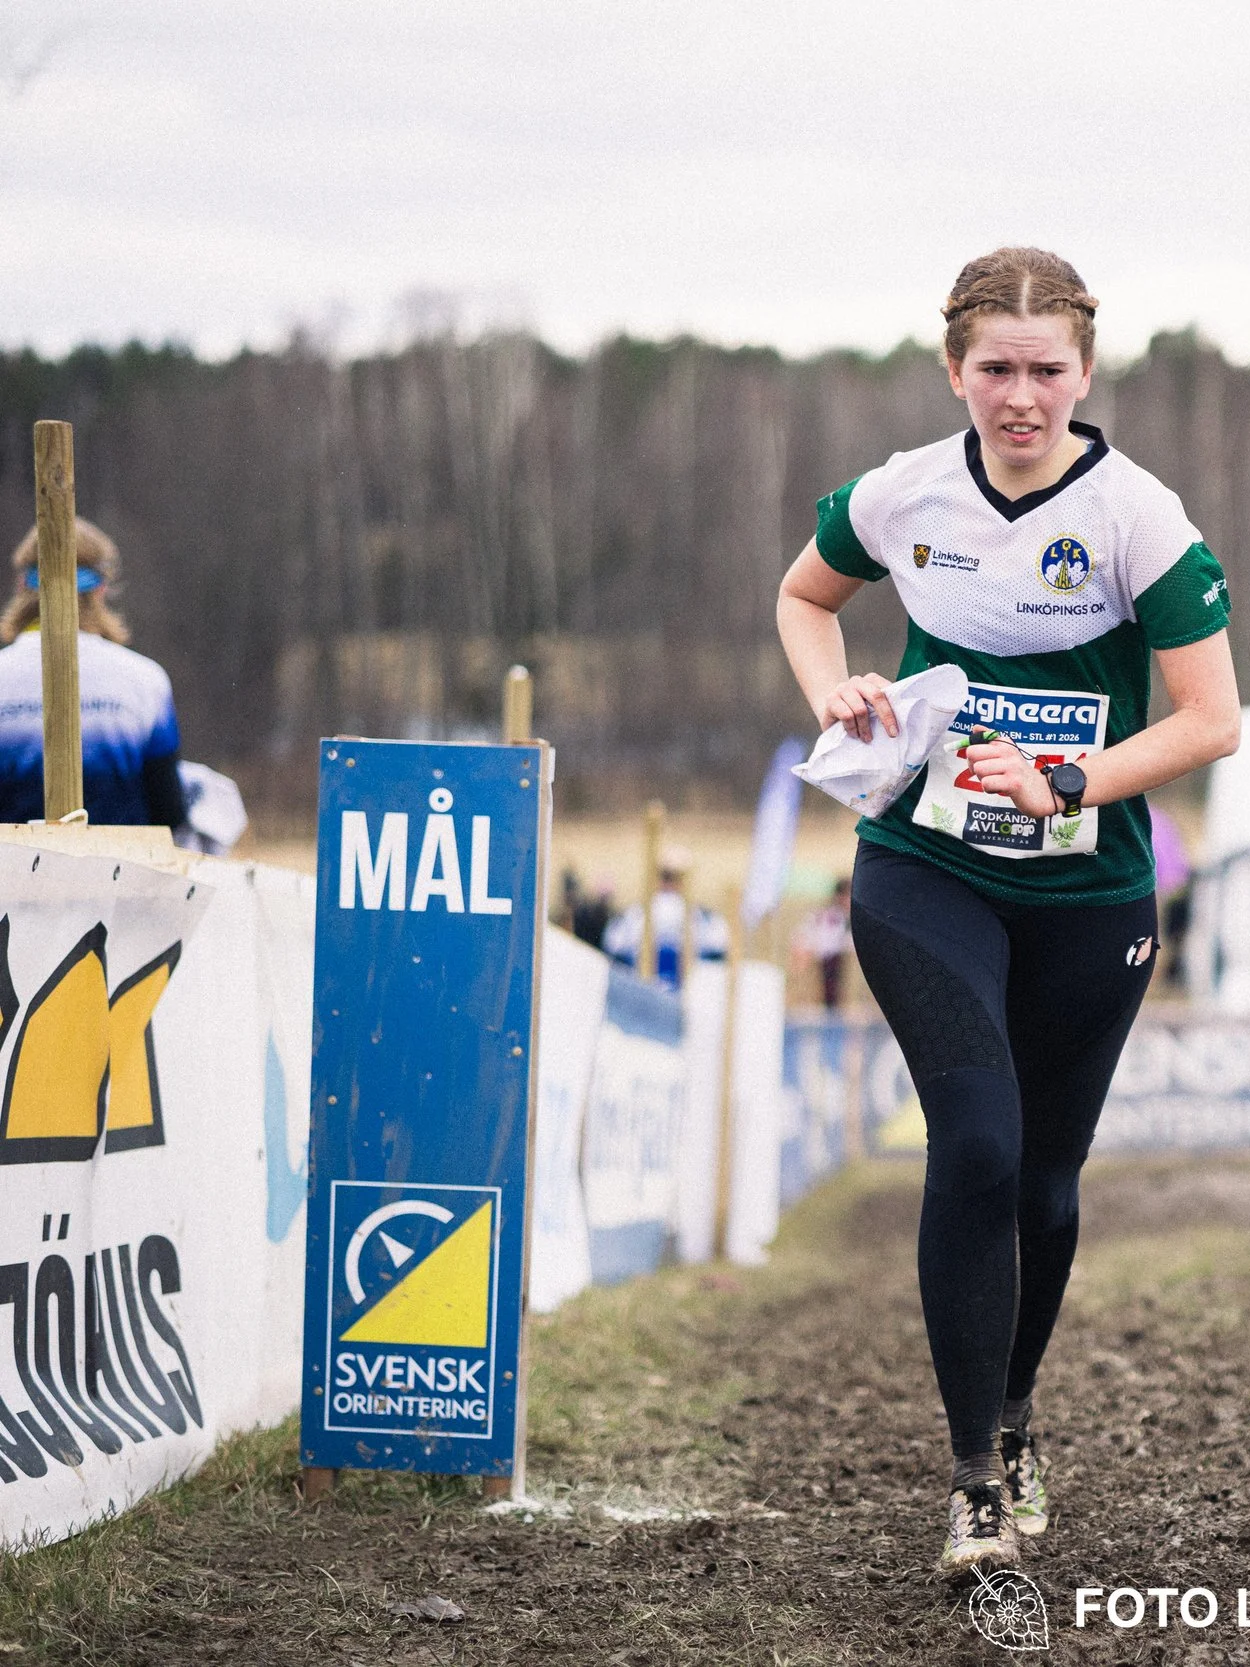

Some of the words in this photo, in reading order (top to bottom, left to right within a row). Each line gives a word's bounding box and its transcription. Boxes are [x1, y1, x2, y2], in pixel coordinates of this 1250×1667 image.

[932, 550, 980, 567] Linköping
[1016, 602, 1088, 615] LINKÖPINGS
[1090, 601, 1106, 614] OK
[960, 695, 1097, 725] agheera
[1029, 733, 1043, 742] STL
[1045, 734, 1056, 742] #1
[1058, 733, 1080, 742] 2026
[971, 809, 1037, 824] GODKÄNDA
[339, 787, 512, 915] MÅL
[335, 1352, 486, 1393] SVENSK
[333, 1392, 487, 1421] ORIENTERING
